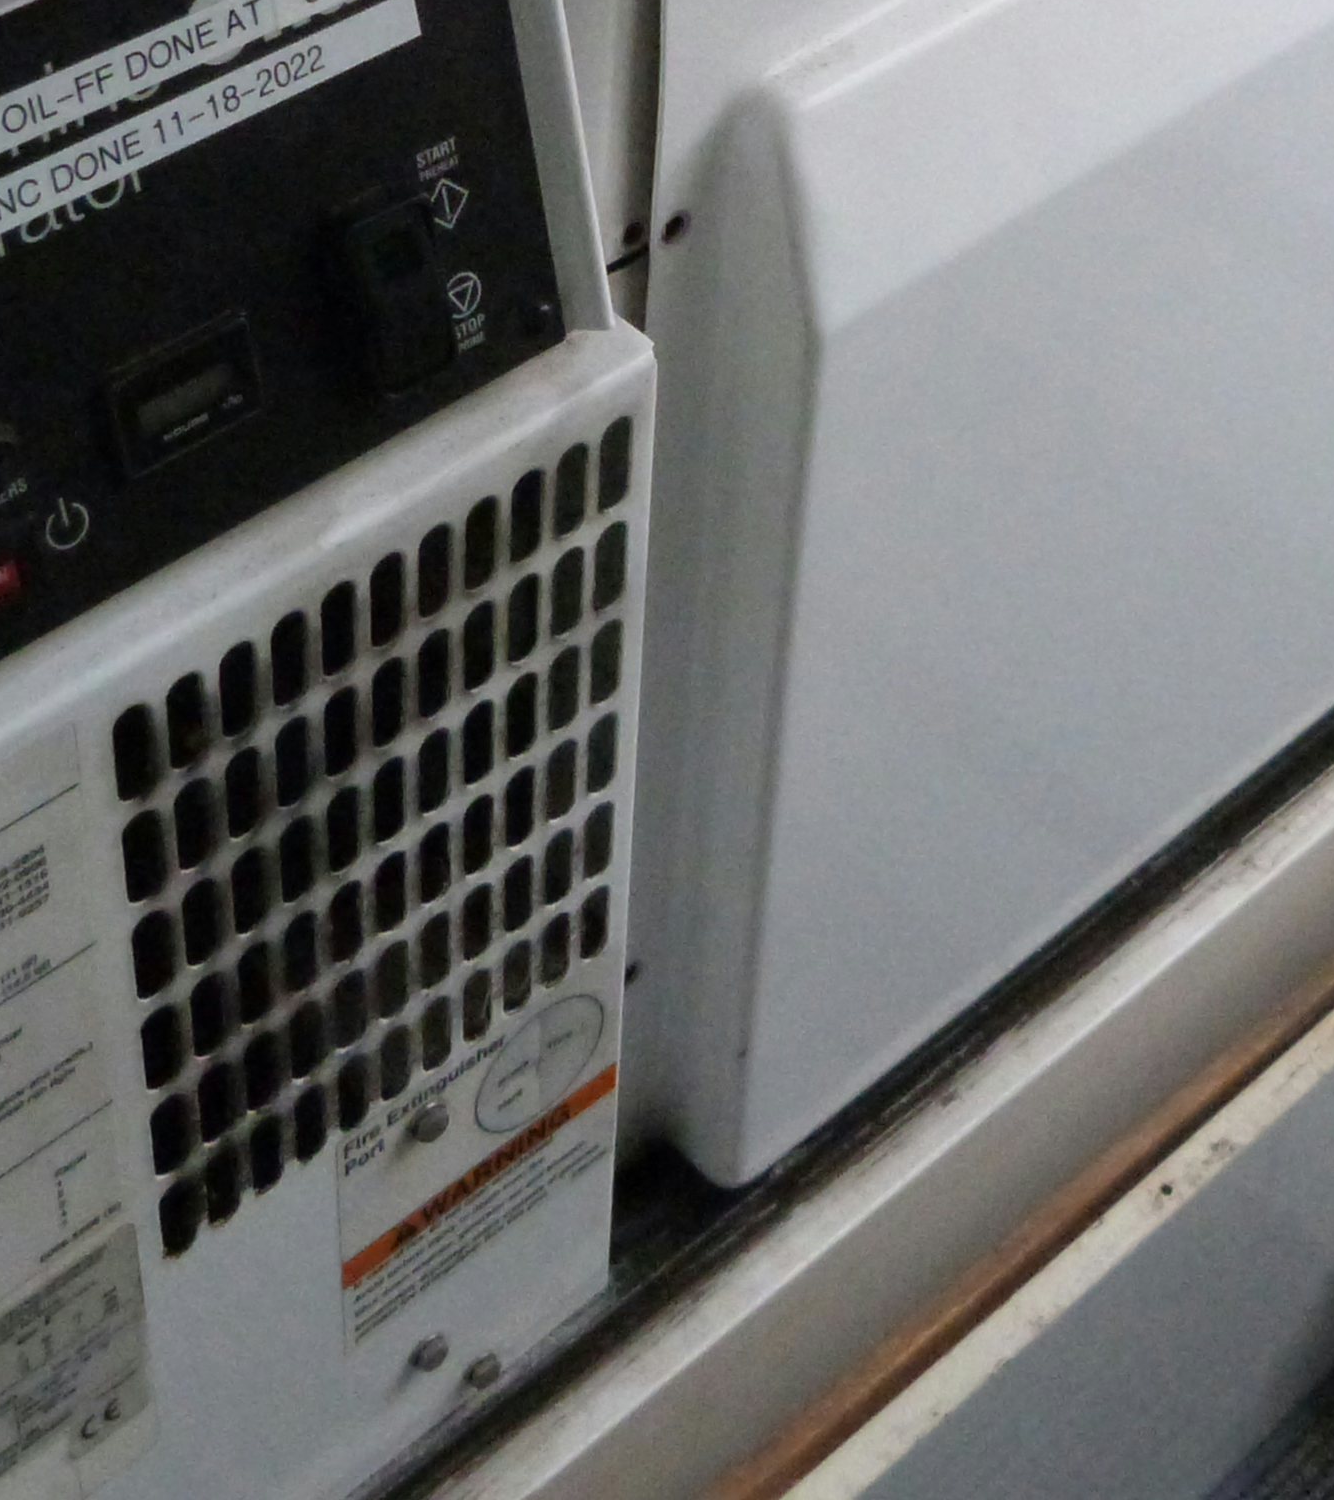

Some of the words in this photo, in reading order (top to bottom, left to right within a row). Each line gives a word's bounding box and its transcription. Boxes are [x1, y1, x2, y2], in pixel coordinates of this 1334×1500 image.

[122, 18, 217, 82] DONE
[48, 128, 144, 195] DONE
[151, 43, 327, 146] 11-18-2022
[415, 135, 458, 169] START
[344, 1119, 380, 1160] Fire
[387, 1029, 504, 1130] Extinguisher
[345, 1134, 384, 1178] Port
[422, 1094, 570, 1230] WARNING
